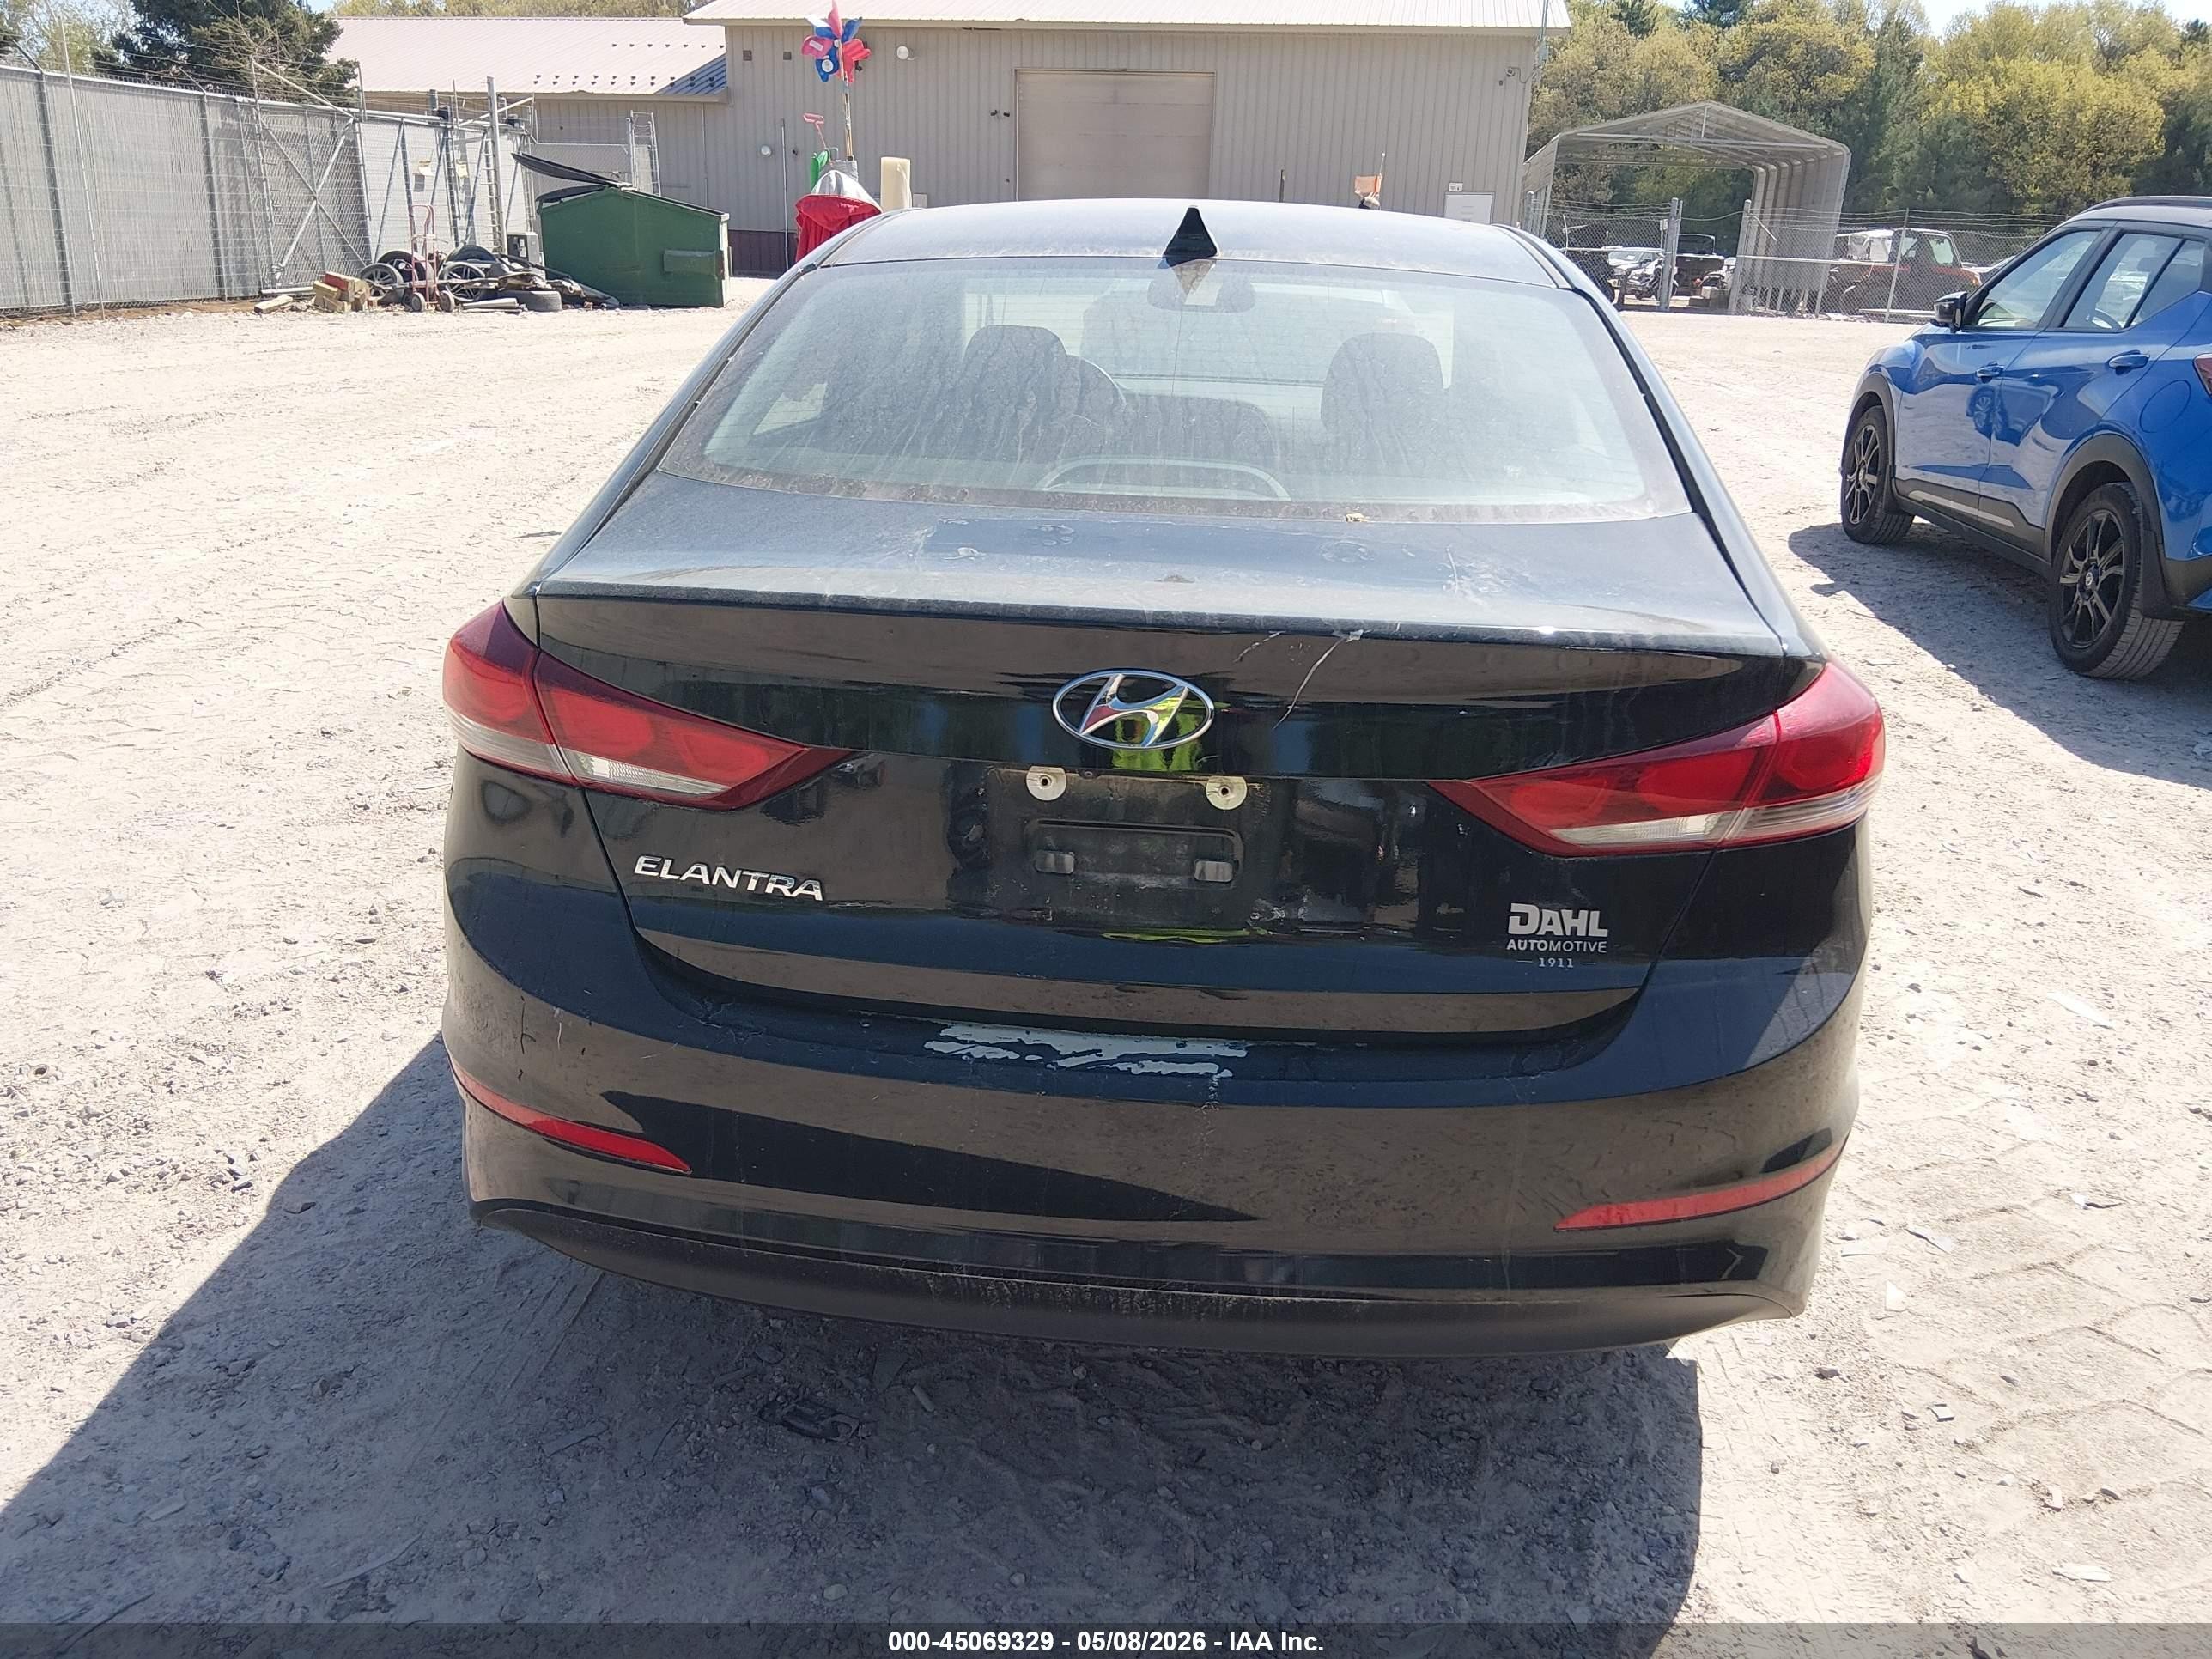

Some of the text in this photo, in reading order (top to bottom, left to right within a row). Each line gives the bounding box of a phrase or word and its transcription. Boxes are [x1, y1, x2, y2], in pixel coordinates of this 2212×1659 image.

[634, 855, 823, 901] ELANTRA
[1508, 902, 1608, 938] DAHL
[1506, 939, 1607, 953] AUTOMOTIVE
[1539, 957, 1574, 968] 1911
